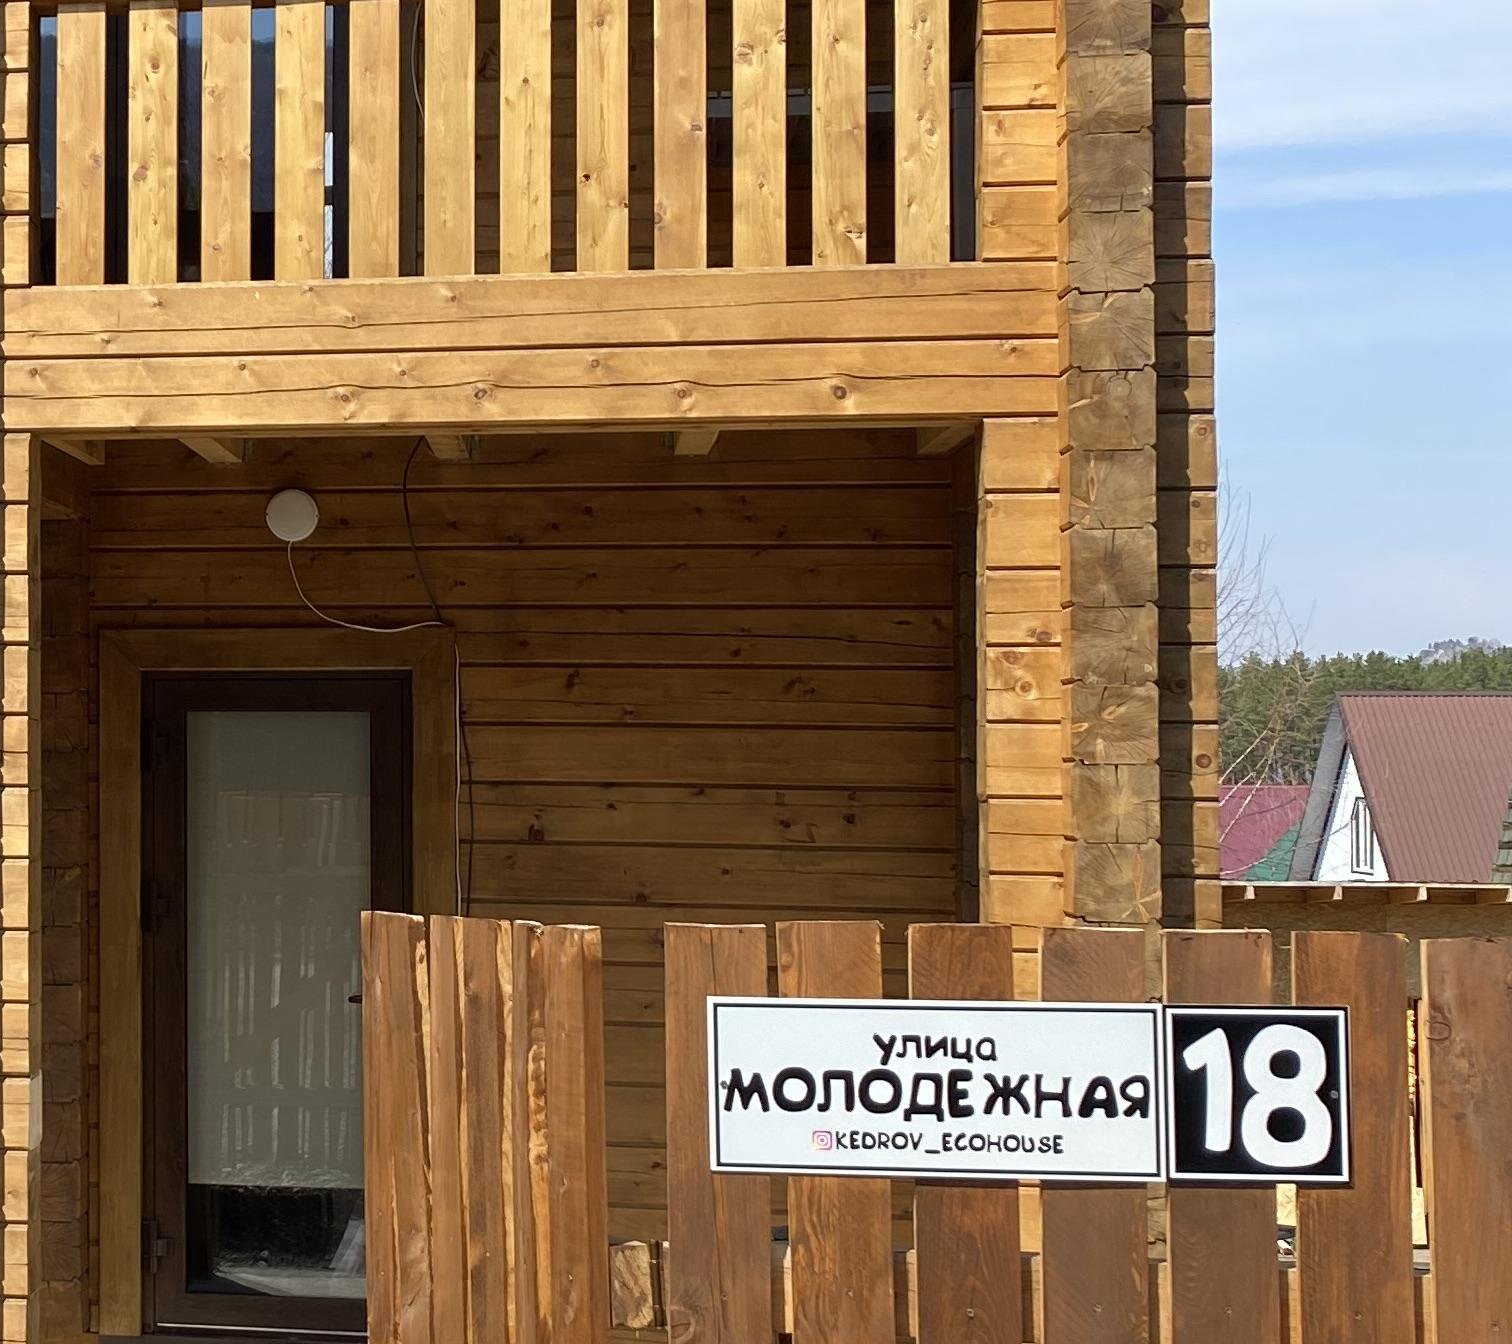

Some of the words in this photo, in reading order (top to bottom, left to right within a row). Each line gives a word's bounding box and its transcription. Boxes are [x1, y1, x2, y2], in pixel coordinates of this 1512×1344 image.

[872, 1033, 997, 1066] улица
[721, 1066, 1150, 1123] МОЛОДЕЖНАЯ
[1182, 1022, 1334, 1169] 18
[834, 1130, 1064, 1155] KEDROV_ECOHOUSE
